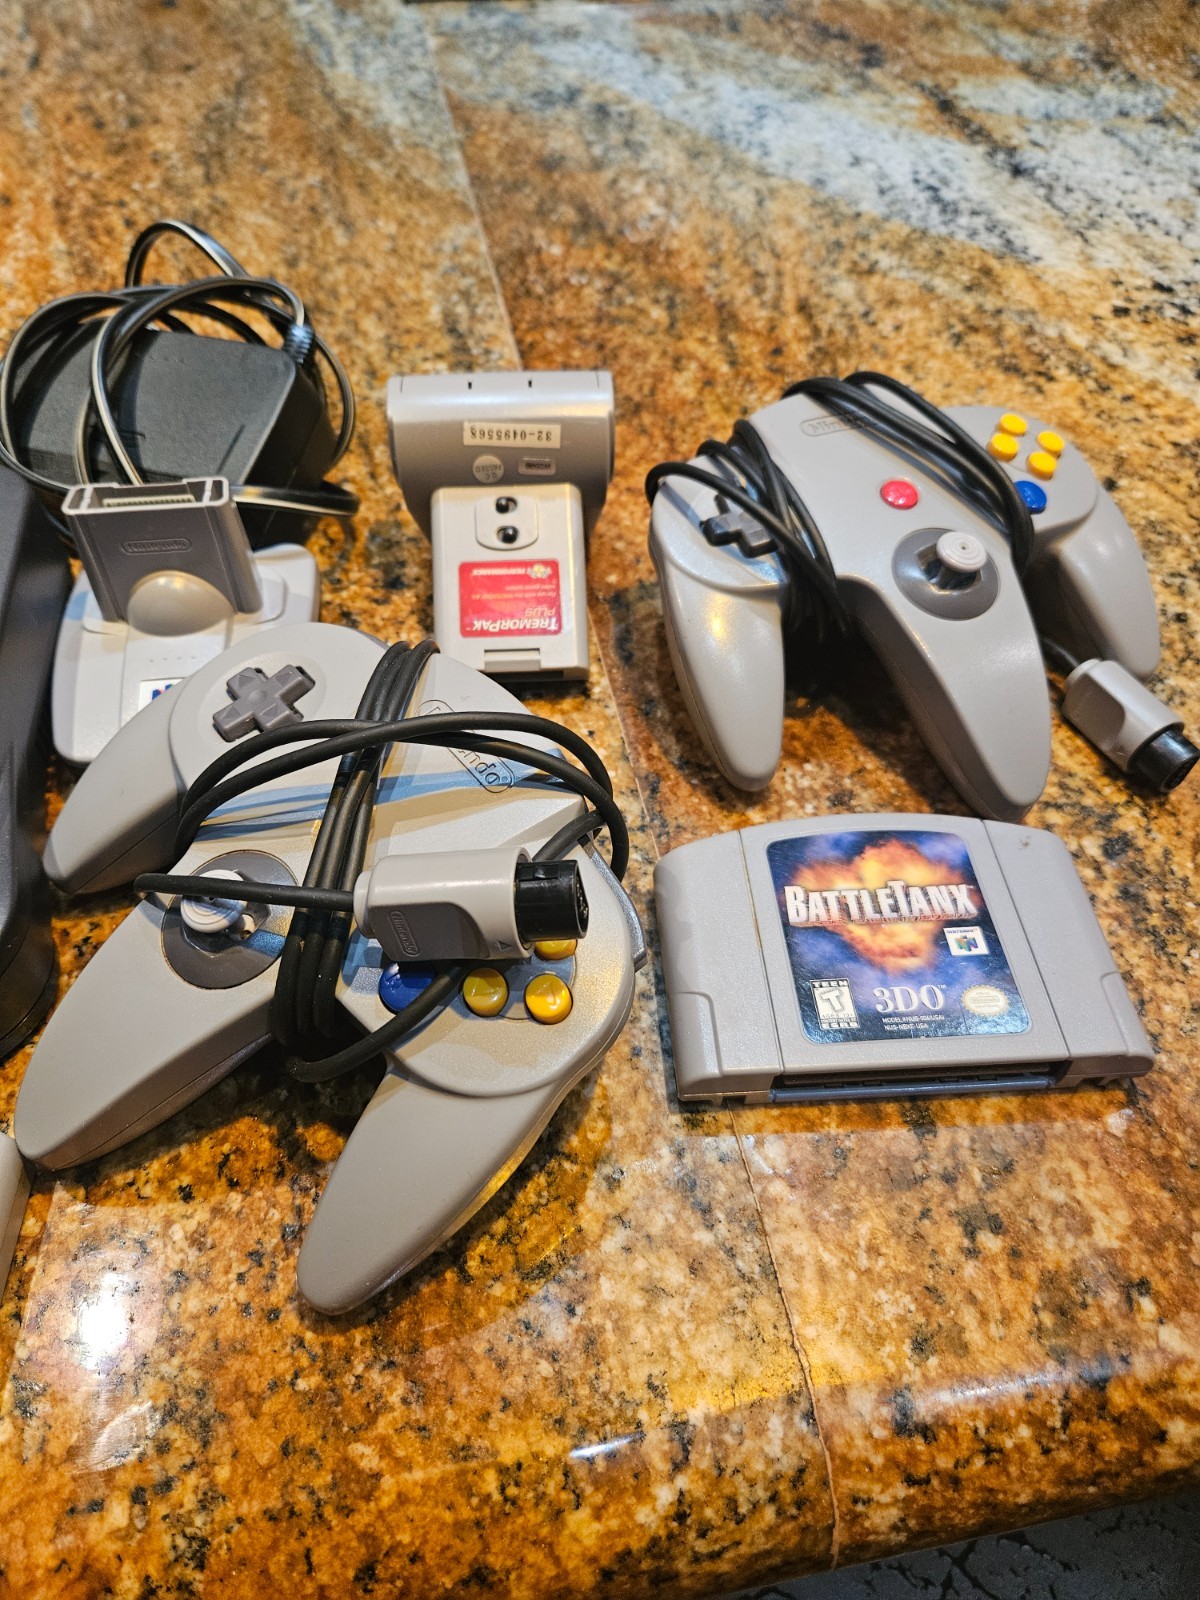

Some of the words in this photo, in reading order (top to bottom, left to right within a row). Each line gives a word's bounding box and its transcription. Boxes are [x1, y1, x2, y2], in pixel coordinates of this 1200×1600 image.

[470, 425, 552, 441] 32-0495568
[524, 606, 556, 617] PLUS
[812, 980, 848, 988] TEEN
[821, 988, 845, 1012] T
